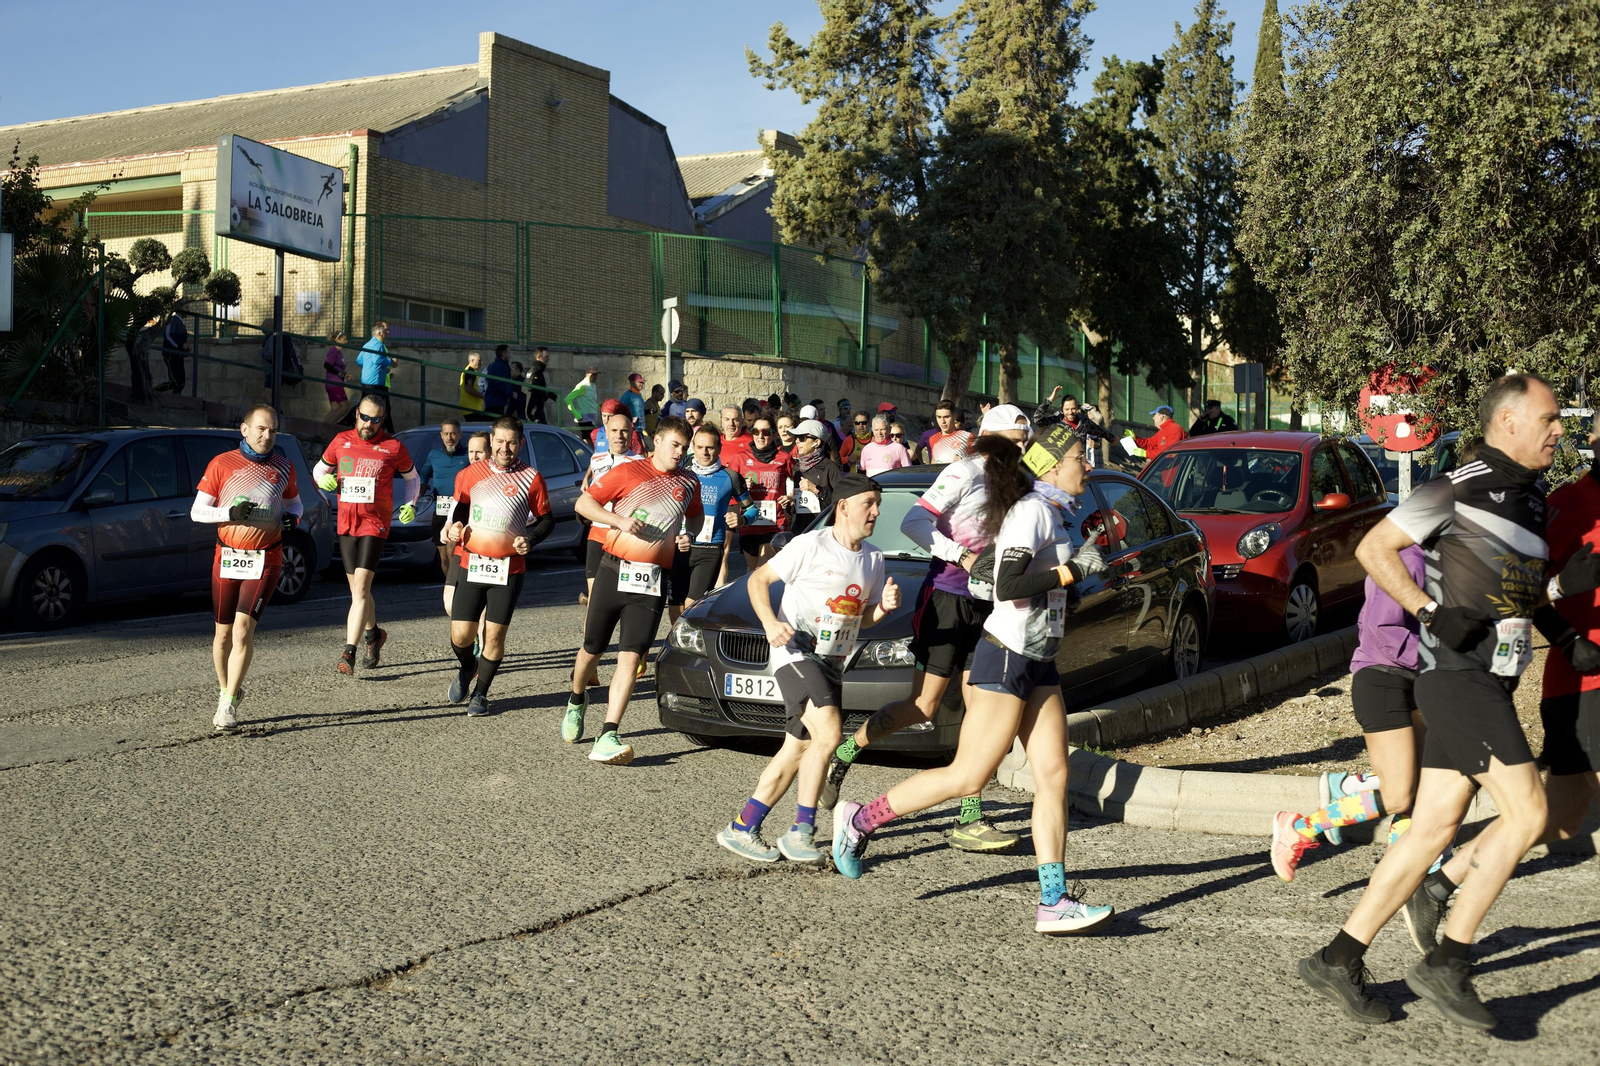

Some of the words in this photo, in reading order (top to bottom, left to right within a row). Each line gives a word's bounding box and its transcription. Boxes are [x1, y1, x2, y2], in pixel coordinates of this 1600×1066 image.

[248, 190, 261, 211] LA
[265, 196, 324, 228] SALOBREJA
[232, 559, 254, 568] 205
[480, 564, 498, 573] 163
[635, 572, 650, 582] 90
[834, 630, 850, 640] 111
[1515, 640, 1528, 655] 55
[736, 677, 774, 697] 5812
